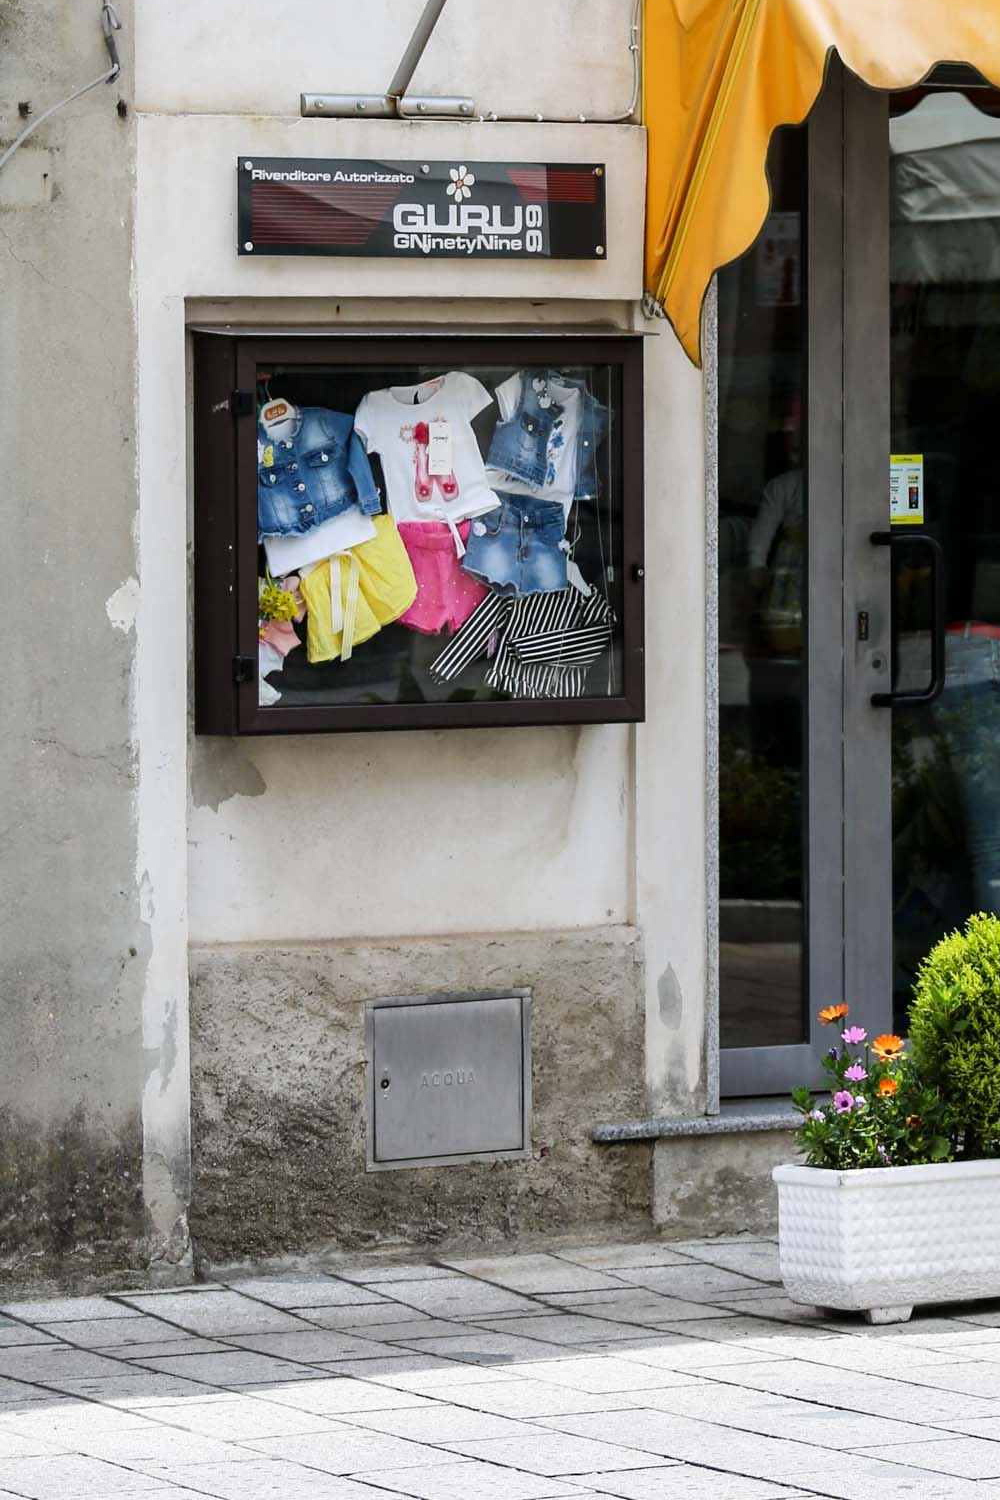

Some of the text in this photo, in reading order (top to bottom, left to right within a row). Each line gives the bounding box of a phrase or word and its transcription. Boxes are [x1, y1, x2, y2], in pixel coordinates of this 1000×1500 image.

[251, 169, 415, 184] Rivenditore Autorizzato
[393, 203, 523, 234] GURU
[394, 230, 522, 254] GNinetyNine
[420, 1068, 477, 1090] ACQUA
